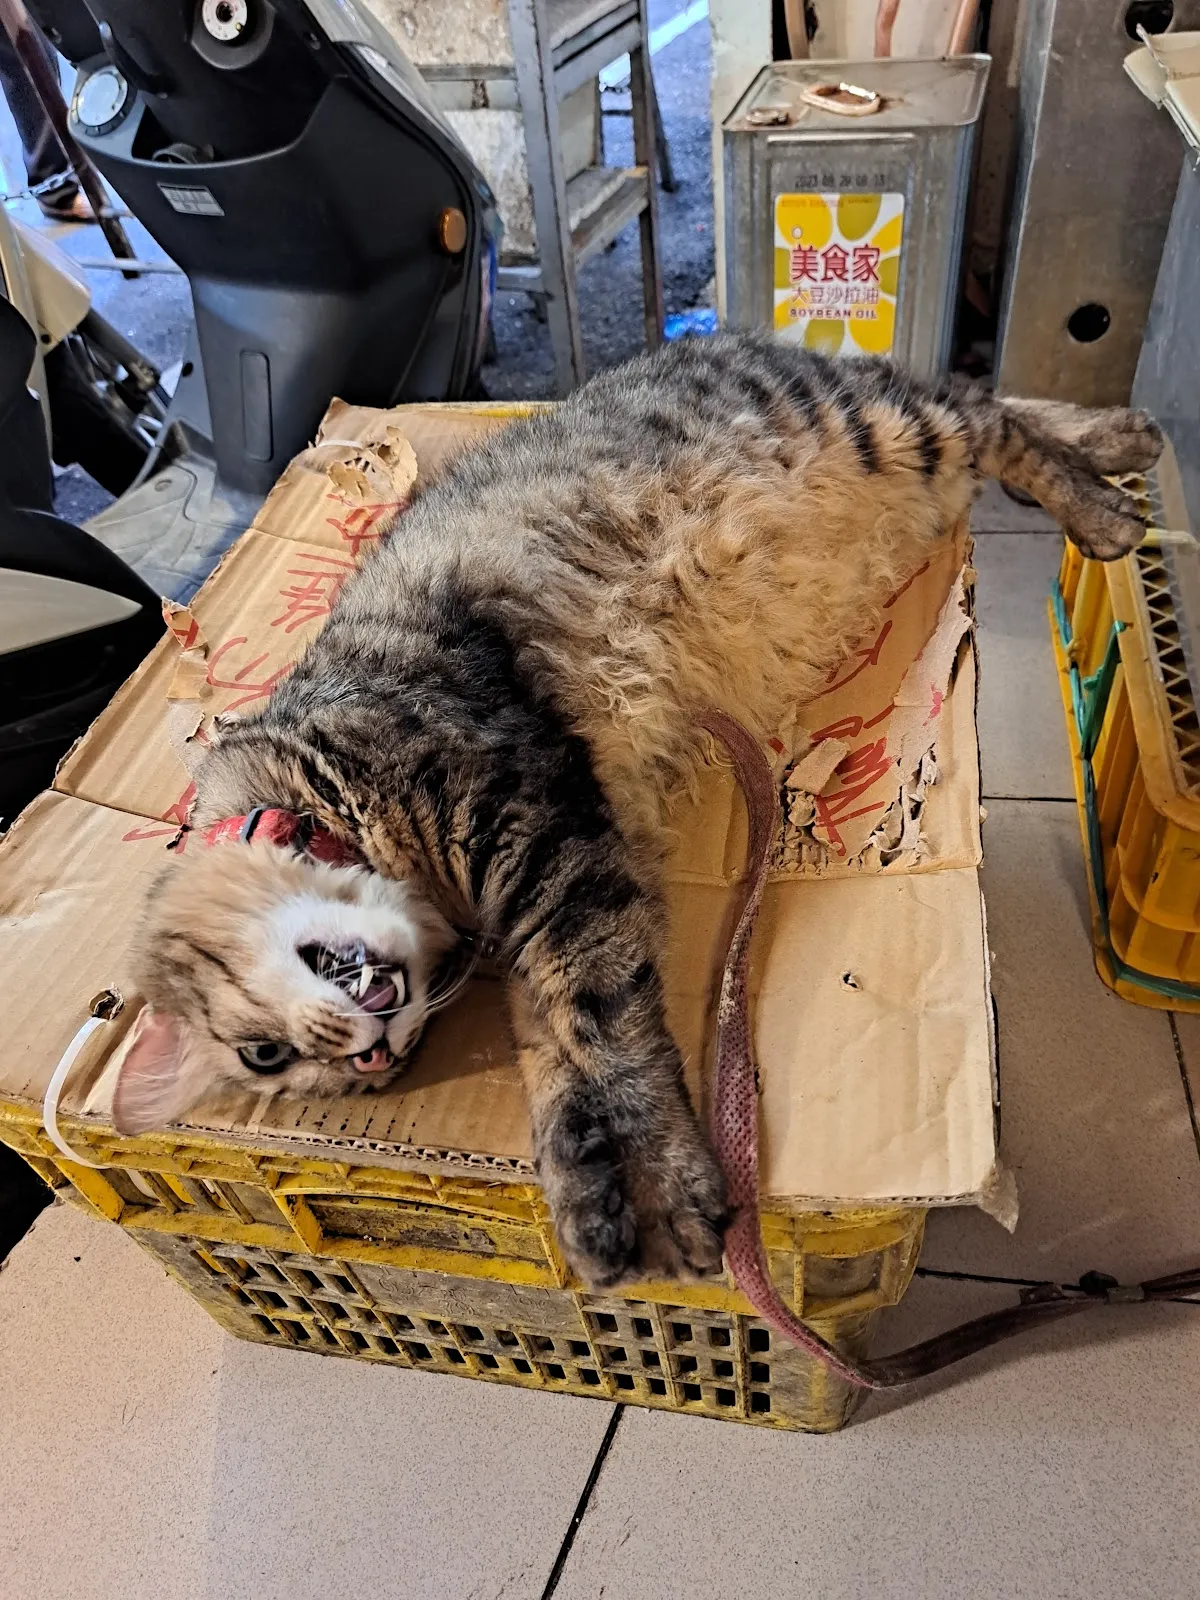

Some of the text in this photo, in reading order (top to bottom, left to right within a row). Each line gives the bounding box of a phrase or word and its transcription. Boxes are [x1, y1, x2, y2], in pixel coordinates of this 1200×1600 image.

[791, 243, 880, 283] 美食家
[791, 286, 879, 305] 大豆沙拉油
[790, 308, 877, 319] SOYBEAN OIL
